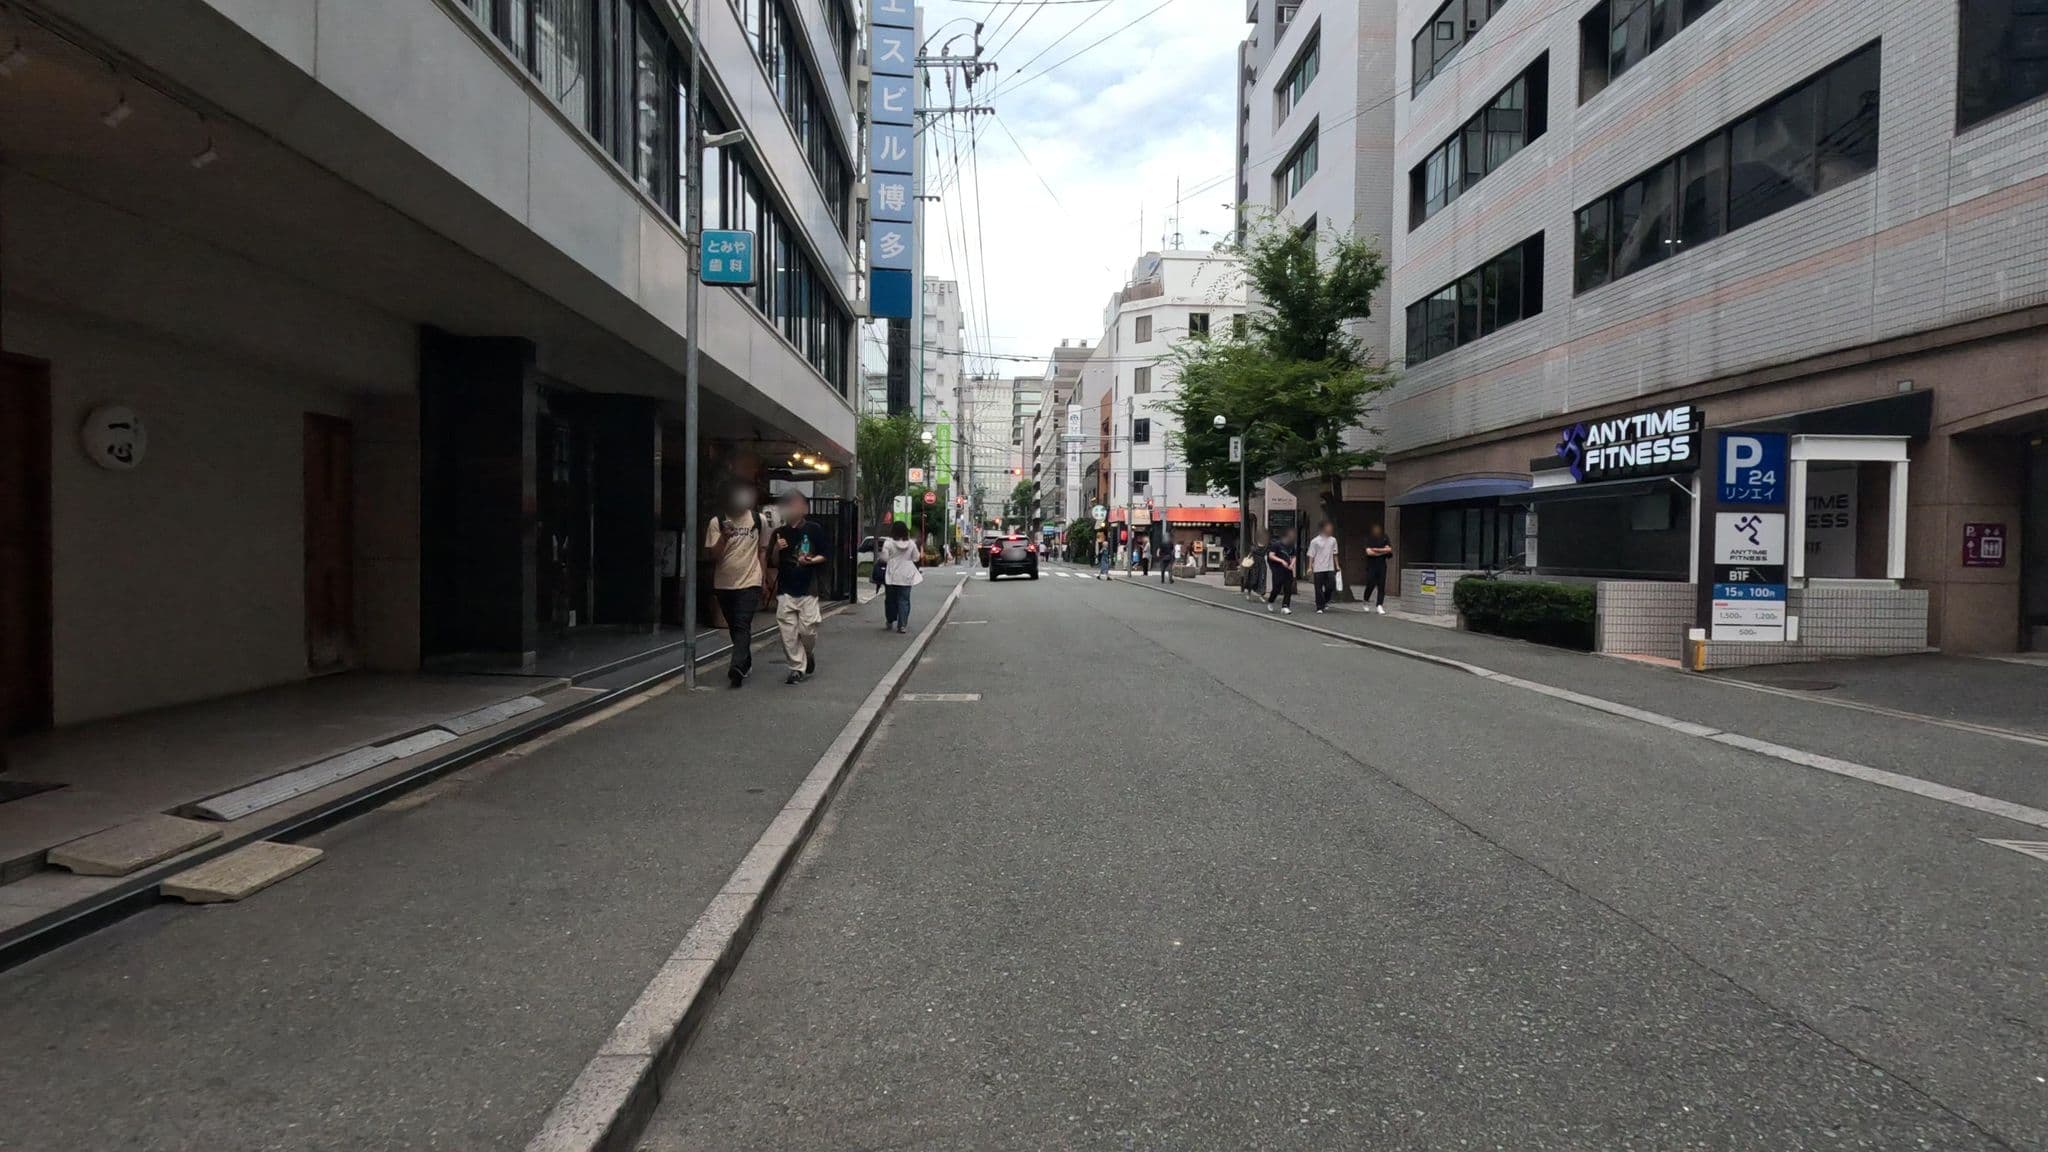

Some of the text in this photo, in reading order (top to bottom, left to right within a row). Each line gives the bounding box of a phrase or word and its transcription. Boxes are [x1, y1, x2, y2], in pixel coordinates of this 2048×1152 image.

[708, 240, 746, 254] とみや
[1586, 405, 1691, 447] ANYTIME
[1585, 435, 1690, 472] FITNESS
[1726, 436, 1777, 485] P 24
[1726, 487, 1775, 500] リンエイ
[1729, 570, 1750, 581] B1F
